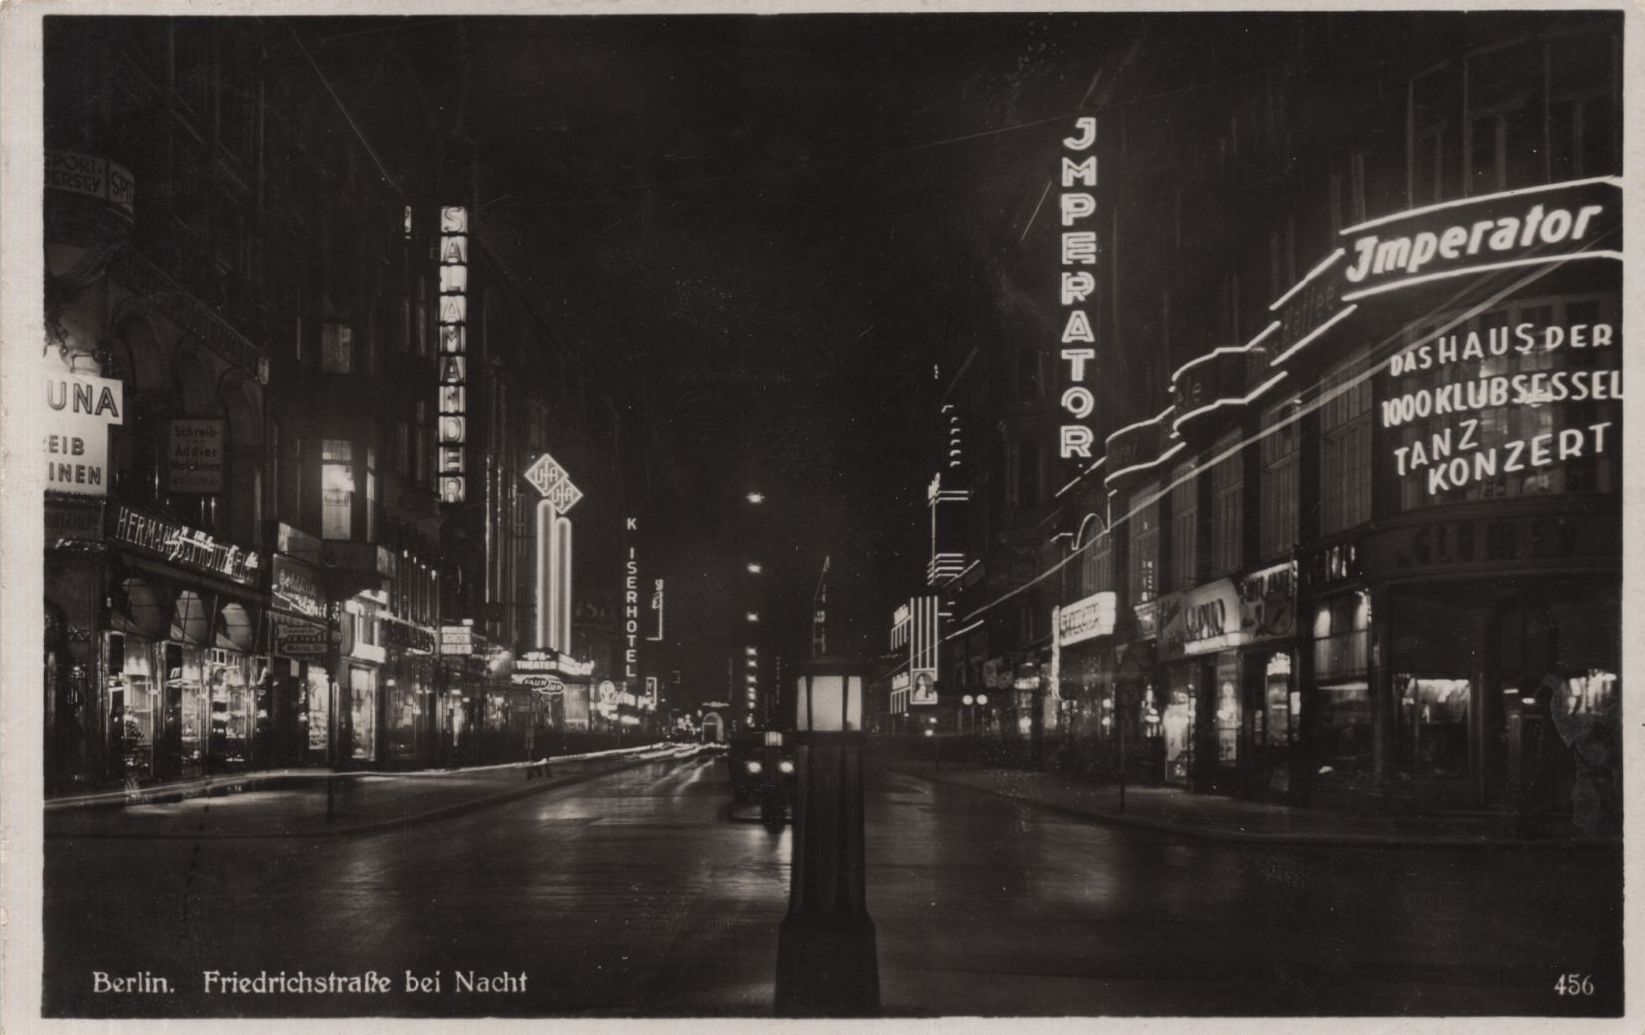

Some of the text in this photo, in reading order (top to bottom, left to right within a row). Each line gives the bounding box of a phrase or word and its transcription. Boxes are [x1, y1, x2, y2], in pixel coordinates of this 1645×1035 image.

[440, 206, 467, 503] SALAMANDER
[1390, 323, 1613, 376] DAS HAUS DER
[1382, 370, 1623, 428] 1000 KLUBSESSEL
[1394, 419, 1479, 476] TANZ
[1429, 422, 1612, 495] KONZERT
[516, 660, 557, 670] THEATER
